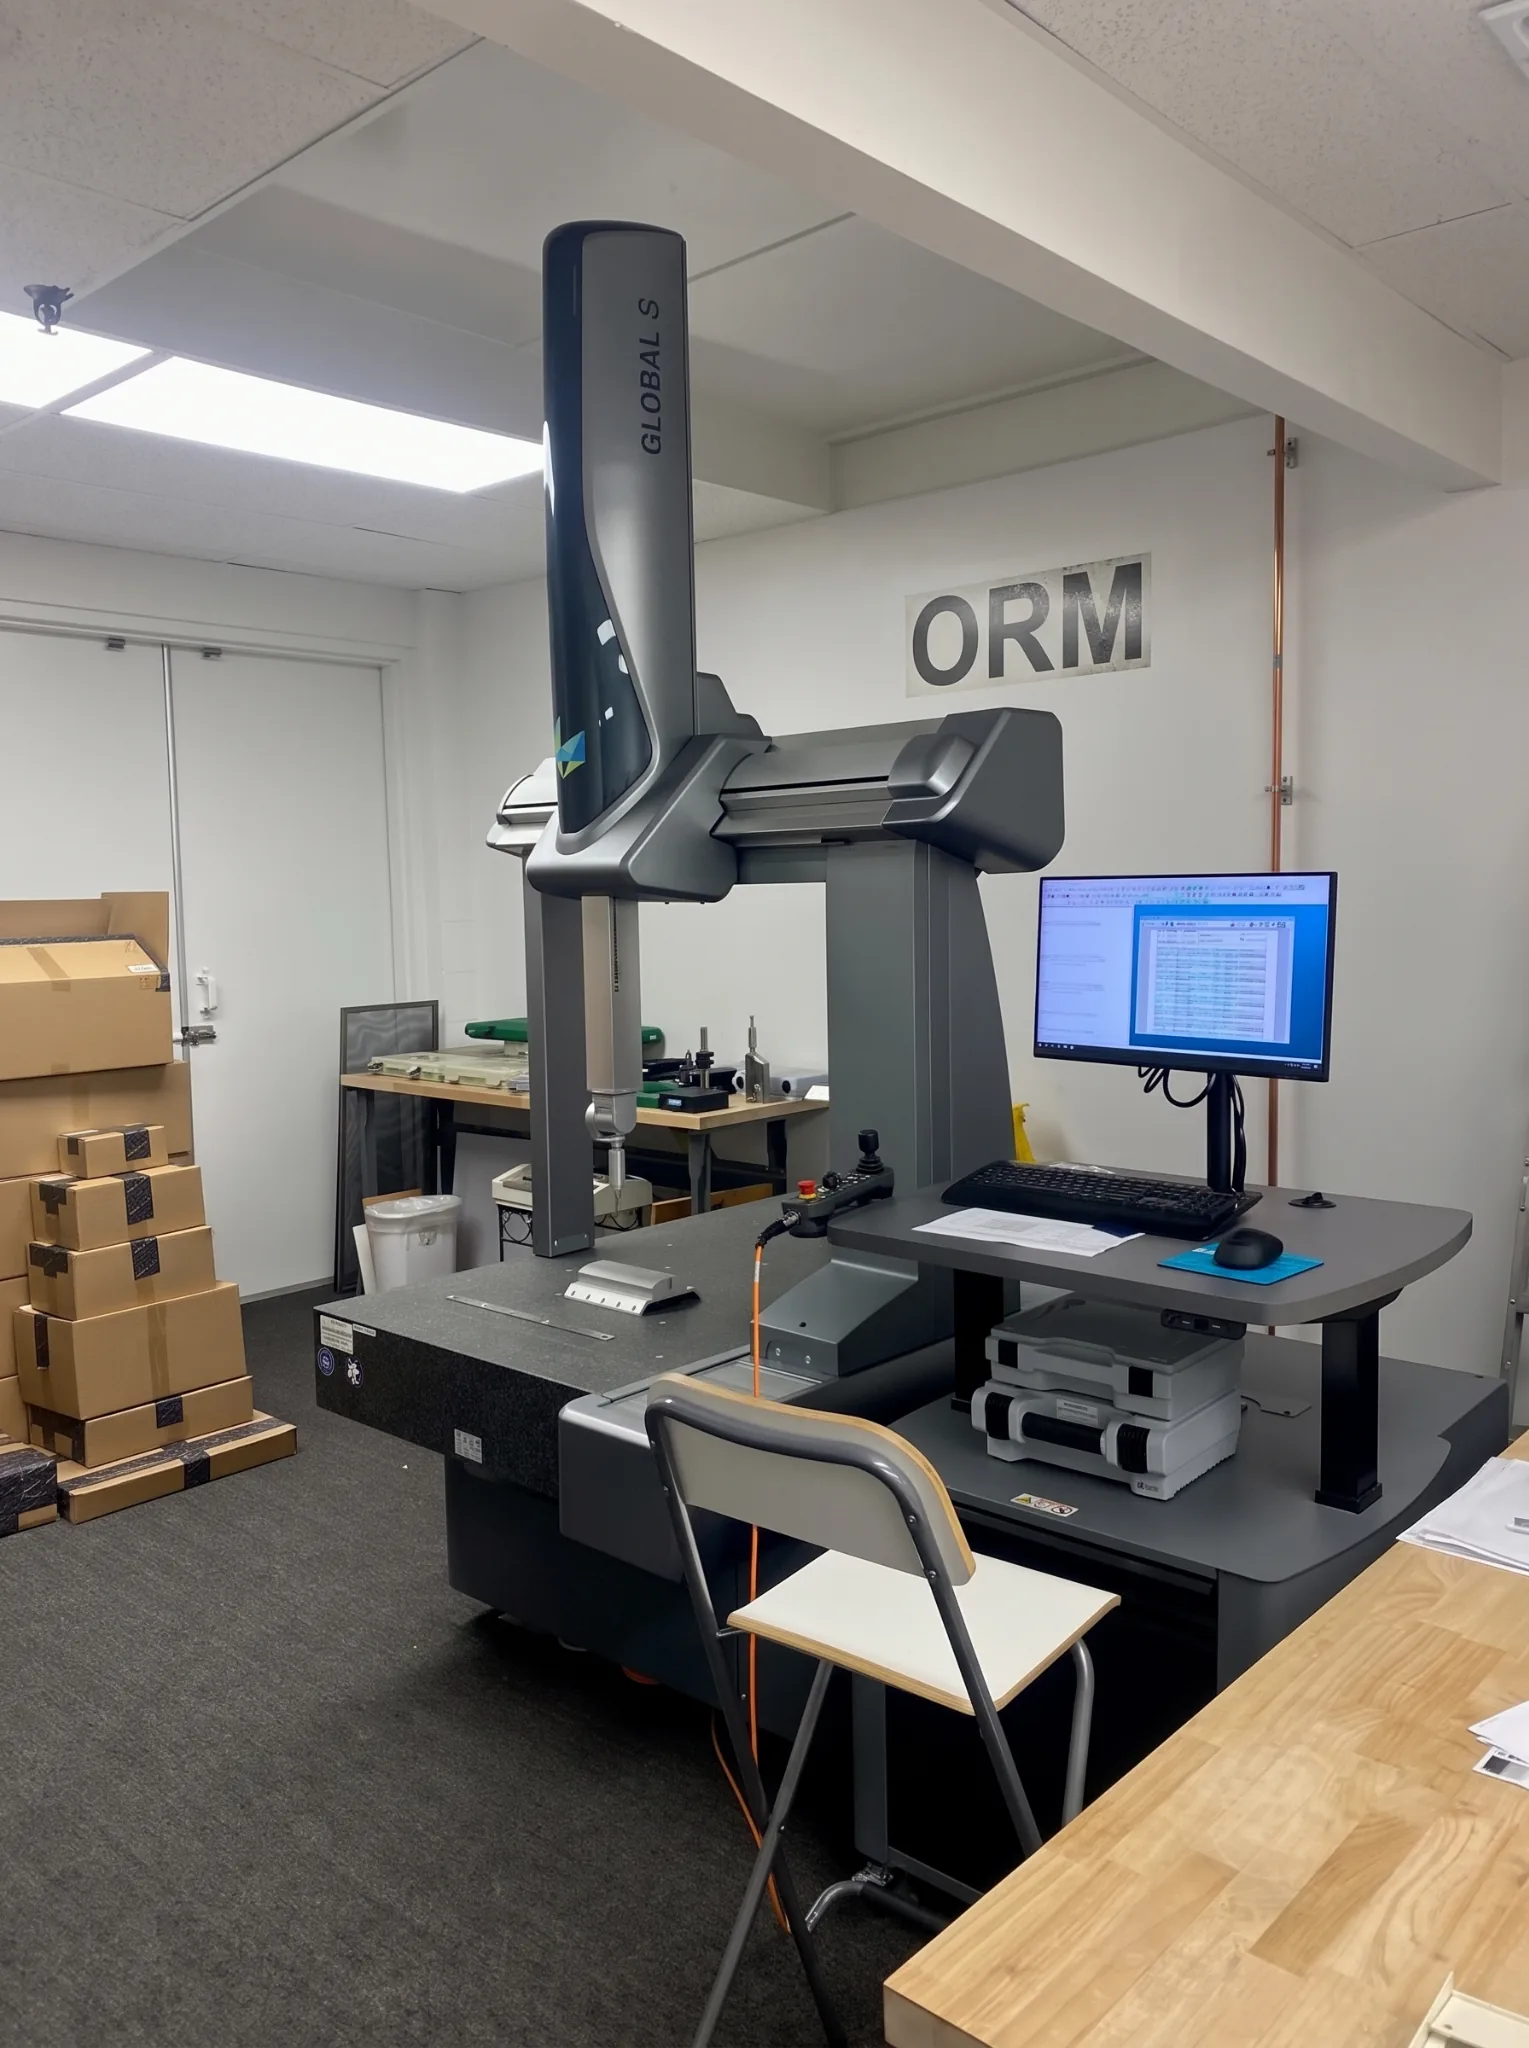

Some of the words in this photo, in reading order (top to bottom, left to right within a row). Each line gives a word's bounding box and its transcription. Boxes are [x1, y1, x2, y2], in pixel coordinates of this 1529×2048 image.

[638, 298, 660, 320] S
[639, 332, 662, 455] GLOBAL
[913, 562, 1142, 686] ORM
